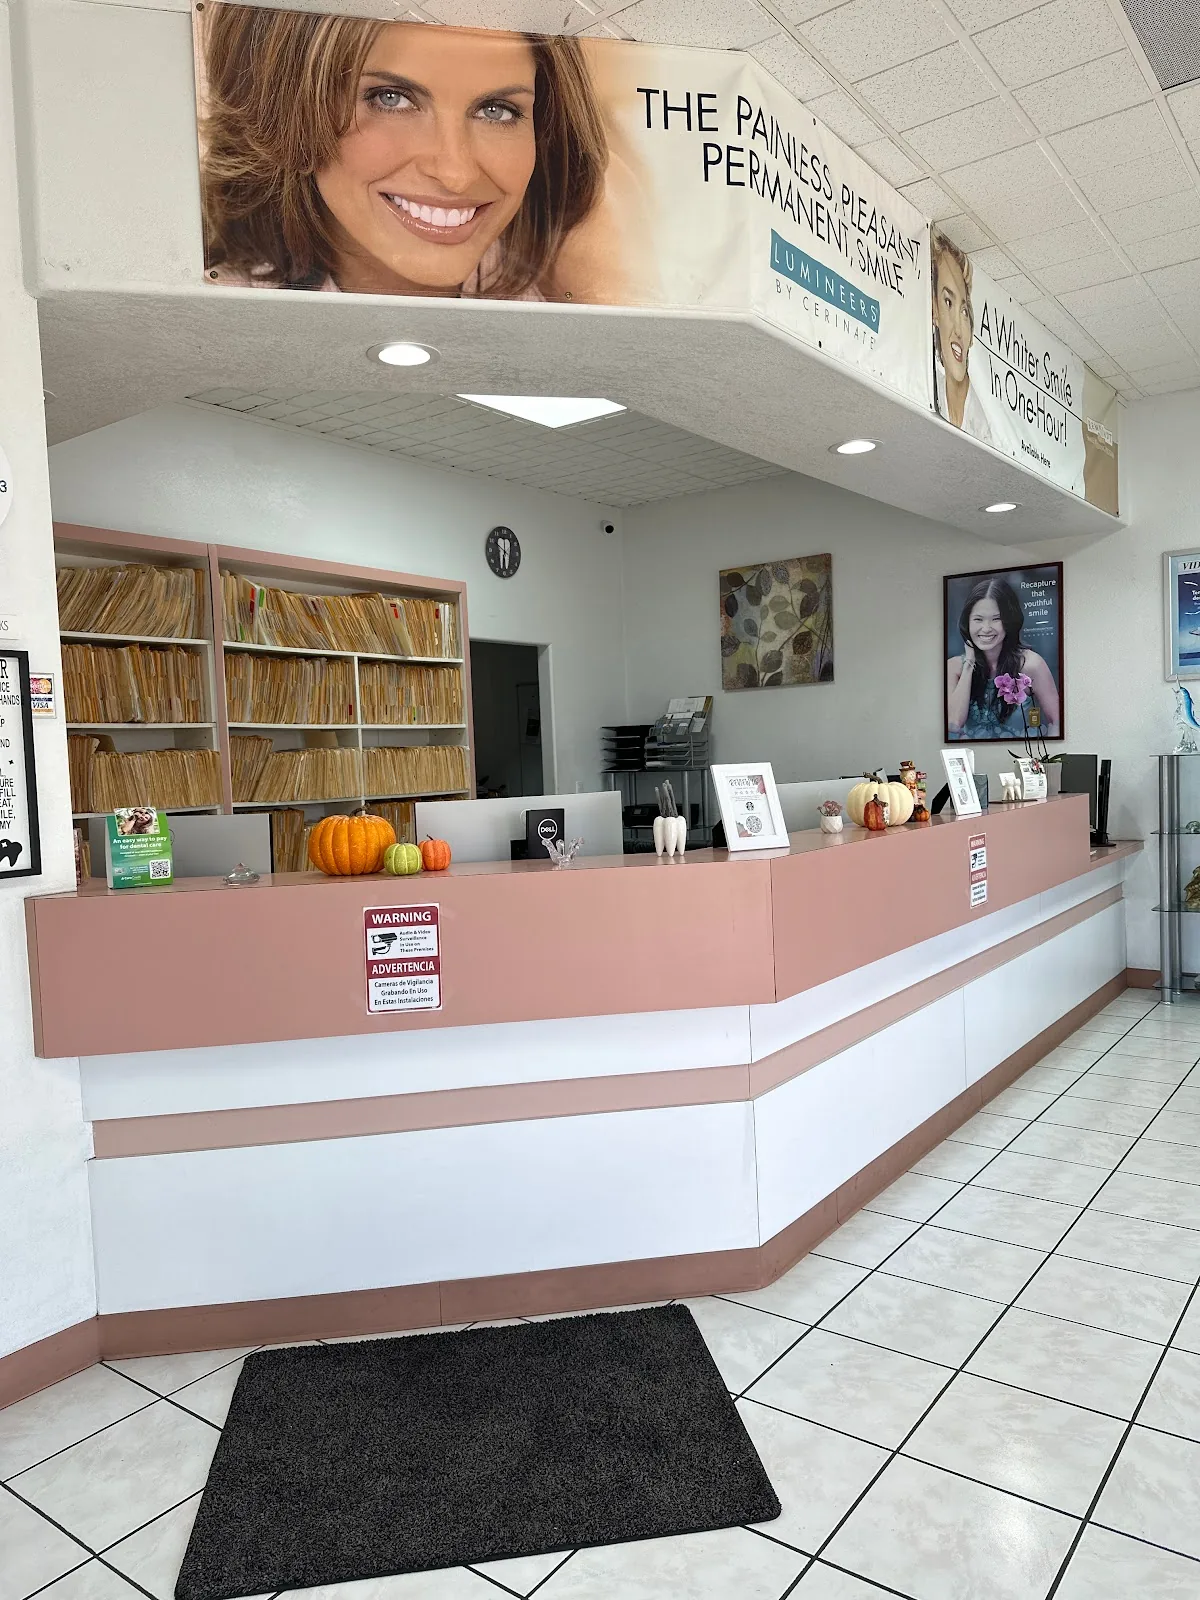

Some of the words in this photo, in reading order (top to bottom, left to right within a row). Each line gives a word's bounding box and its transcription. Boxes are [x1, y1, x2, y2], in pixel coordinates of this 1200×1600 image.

[636, 87, 719, 132] THE
[736, 95, 839, 212] PAINLESS,
[841, 183, 921, 280] PLEASANT,
[702, 142, 854, 268] PERMANENT,
[856, 238, 905, 298] SMILE.
[774, 240, 878, 324] LUMINEERS
[775, 279, 793, 300] BY
[802, 296, 875, 350] CERINATE
[980, 300, 992, 346] A
[994, 307, 1040, 381] Whiter
[1043, 351, 1073, 407] Smile
[989, 354, 1002, 401] In
[1005, 369, 1067, 448] One-Hour!
[1021, 439, 1040, 462] Available
[1040, 452, 1050, 469] Here
[1020, 579, 1056, 589] Recapture
[1031, 589, 1045, 597] that
[1023, 598, 1053, 609] youthful
[1028, 608, 1048, 617] smile
[32, 701, 49, 709] VISA
[371, 911, 432, 924] WARNING
[371, 960, 435, 975] ADVERTENCIA
[374, 980, 399, 988] Cameras
[406, 978, 433, 987] Vigilancia
[381, 988, 409, 996] Grabando
[397, 996, 434, 1004] Instalaciones
